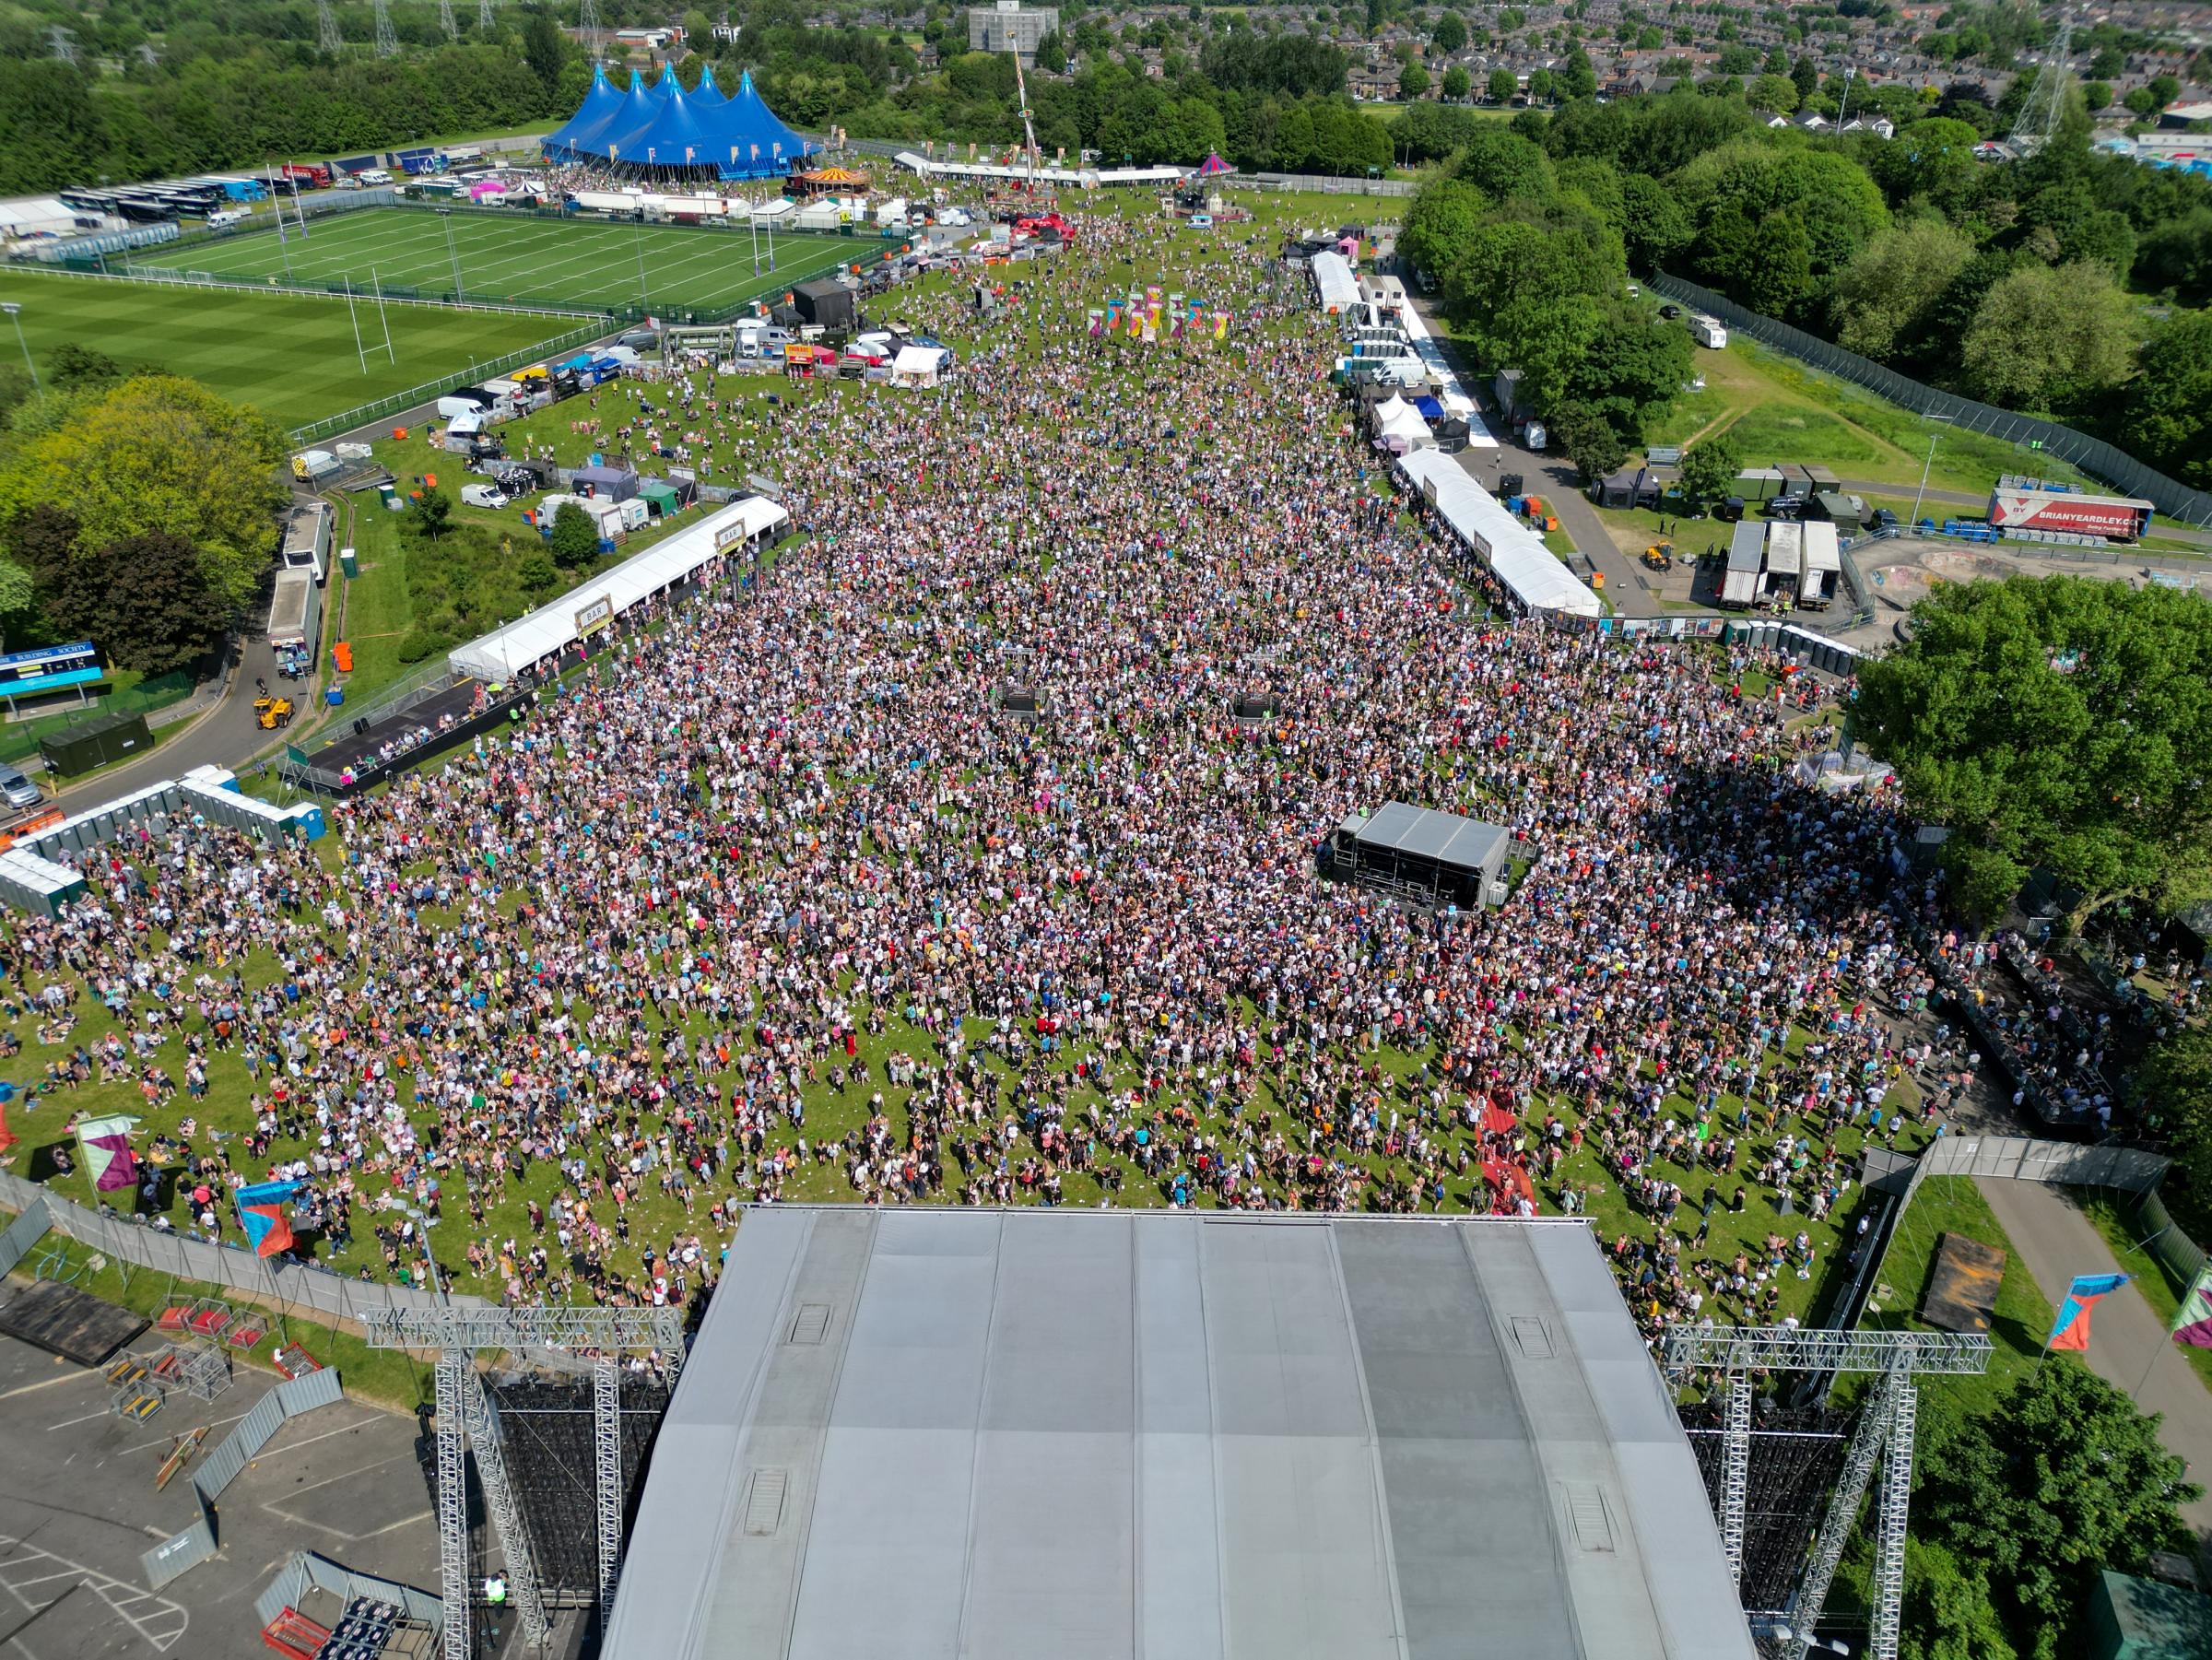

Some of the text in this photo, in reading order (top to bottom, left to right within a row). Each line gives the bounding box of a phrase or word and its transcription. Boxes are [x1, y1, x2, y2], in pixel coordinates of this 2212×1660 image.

[725, 529, 736, 541] BAR
[586, 606, 602, 621] BAR
[16, 650, 53, 661] BUILDING
[57, 644, 87, 653] SOCIETY
